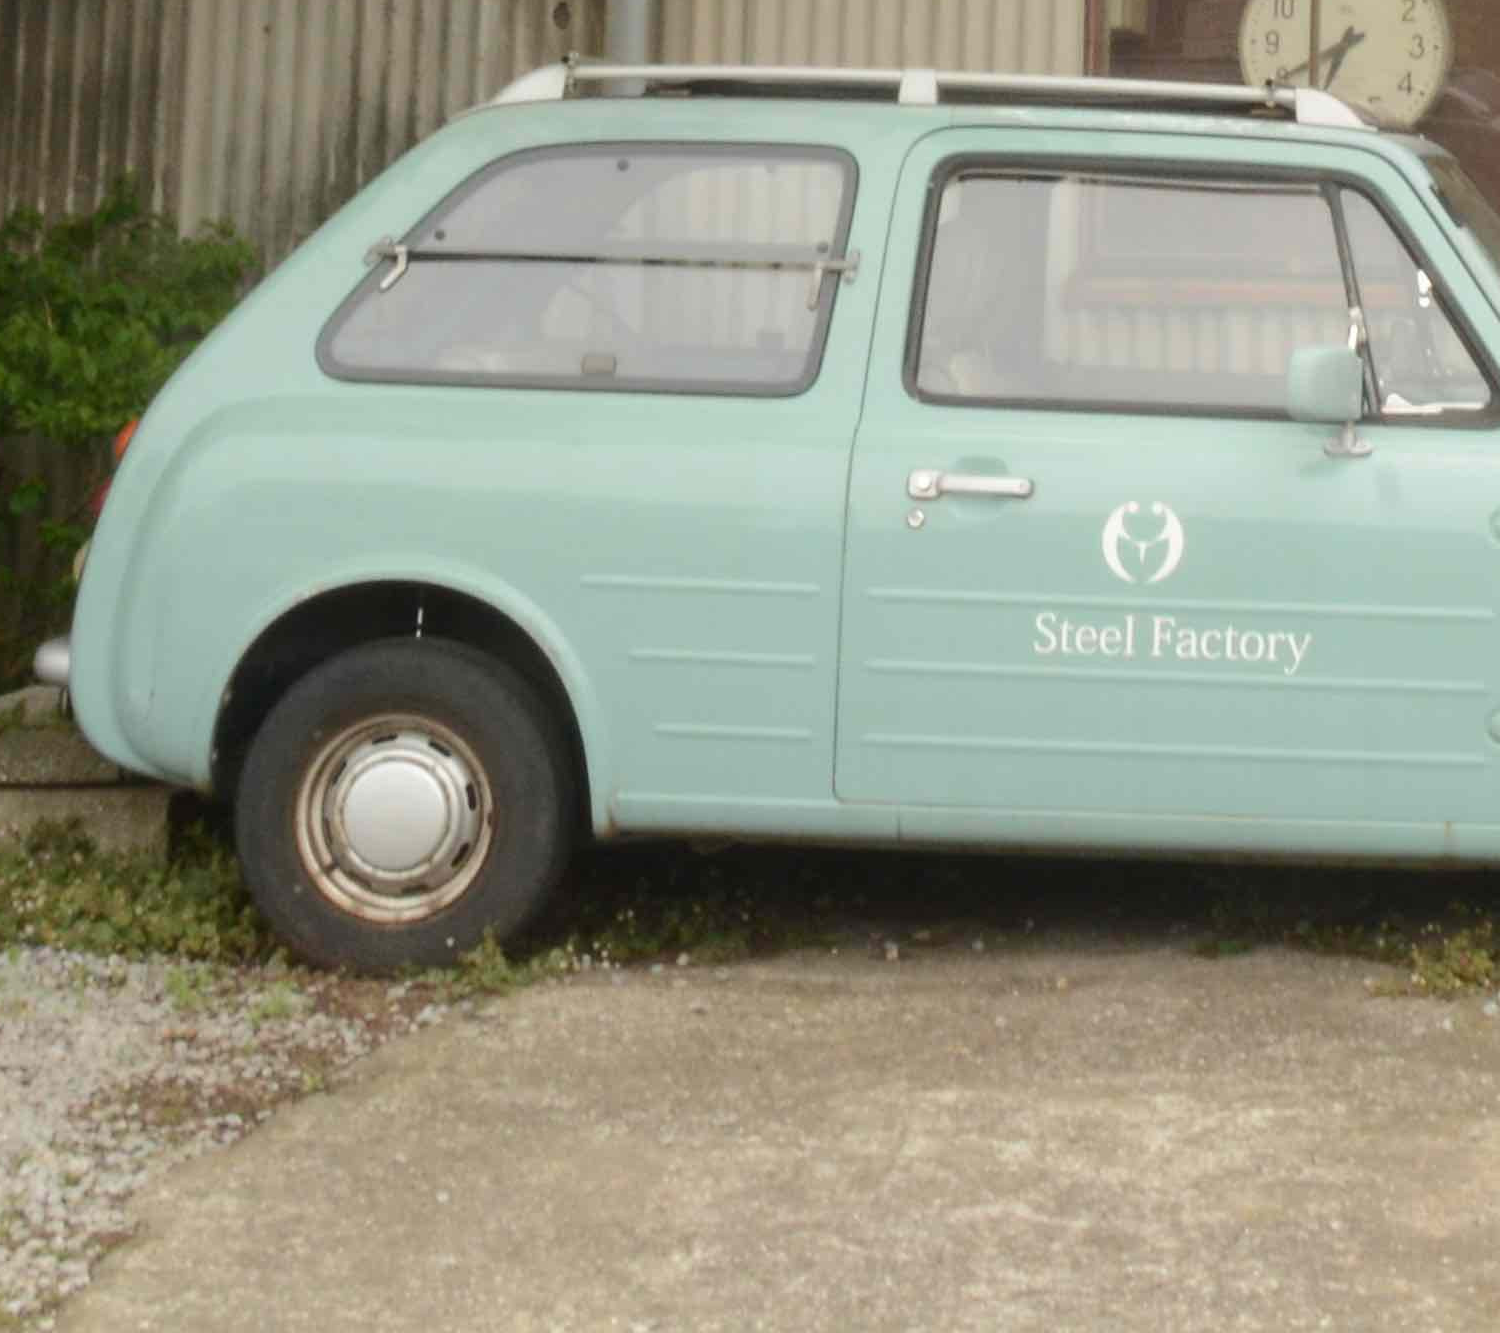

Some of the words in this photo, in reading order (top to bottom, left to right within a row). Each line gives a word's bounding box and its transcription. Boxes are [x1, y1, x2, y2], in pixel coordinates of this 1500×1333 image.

[1265, 30, 1280, 55] 9
[1409, 34, 1425, 60] 3
[1397, 71, 1413, 95] 4
[1032, 610, 1136, 658] Steel
[1150, 614, 1313, 676] Factory
